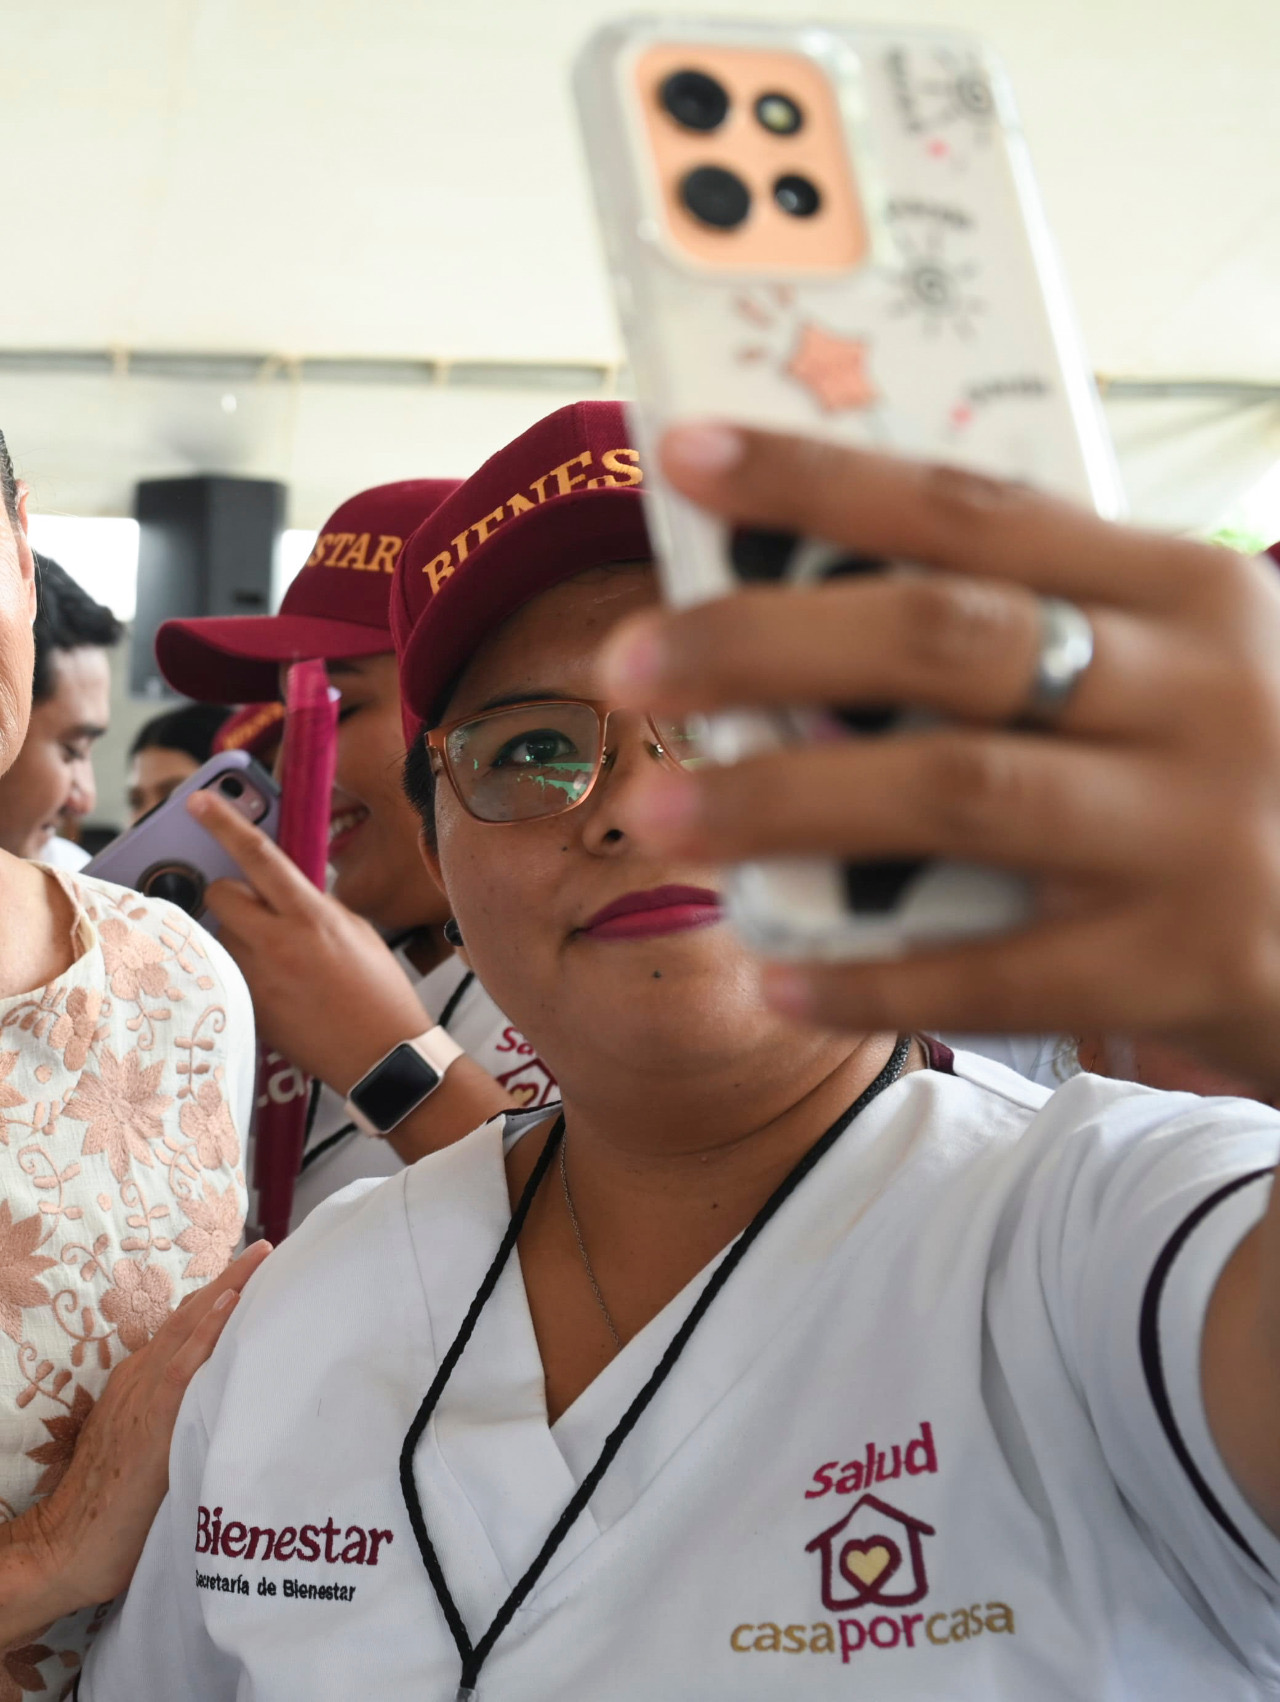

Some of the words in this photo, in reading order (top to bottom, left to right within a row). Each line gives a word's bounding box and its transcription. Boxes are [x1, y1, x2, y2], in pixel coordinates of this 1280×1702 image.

[804, 1421, 938, 1499] salud
[195, 1505, 394, 1566] Bienestar
[196, 1569, 250, 1596] Secretaría
[257, 1576, 277, 1597] de
[283, 1578, 356, 1602] Bienestar
